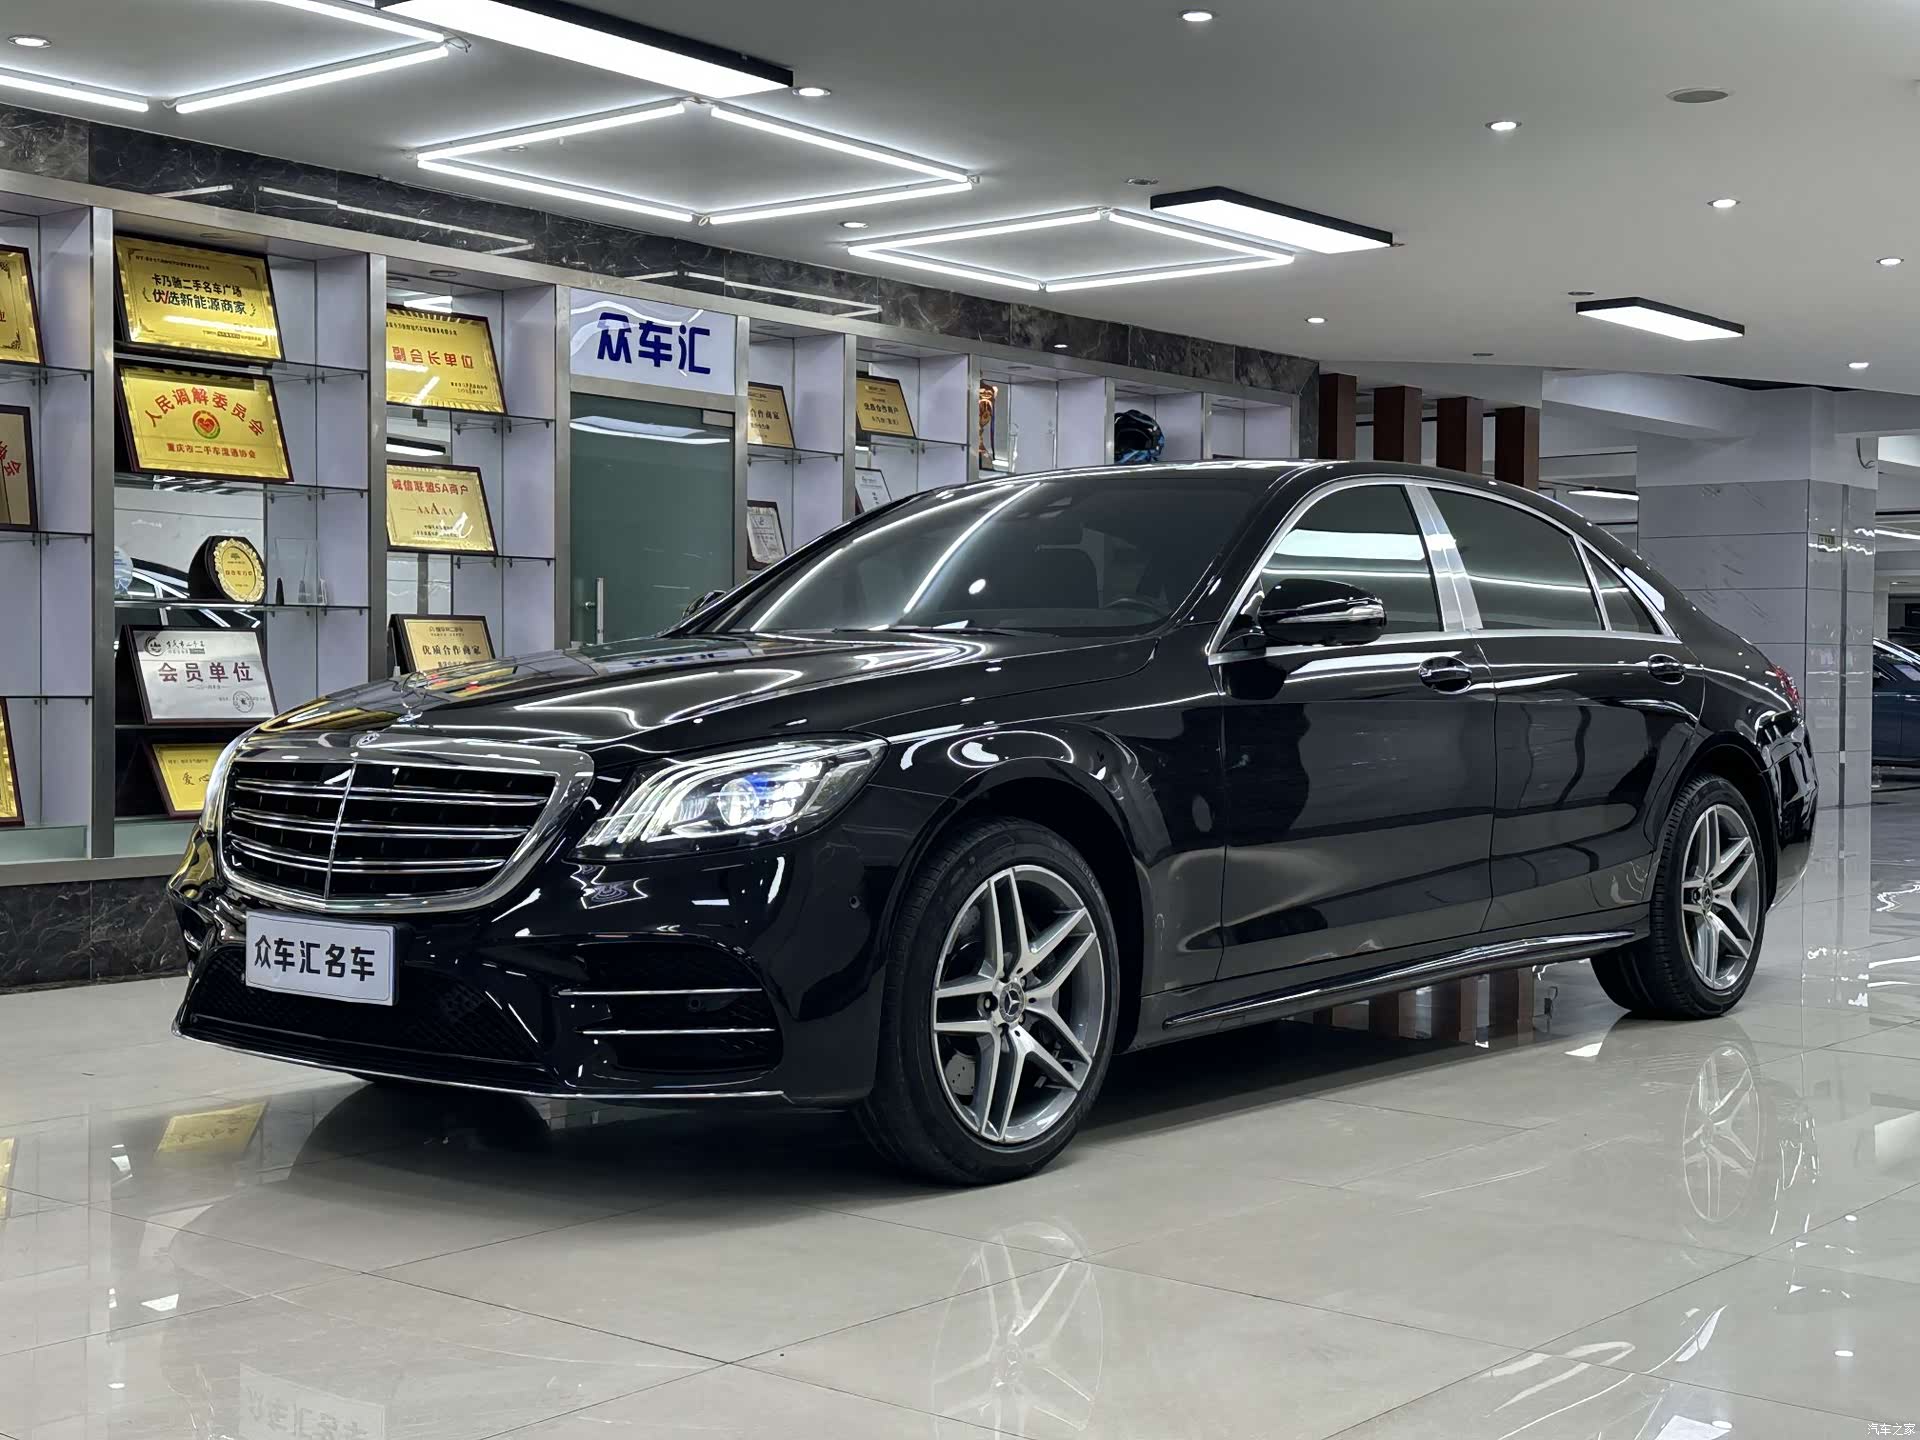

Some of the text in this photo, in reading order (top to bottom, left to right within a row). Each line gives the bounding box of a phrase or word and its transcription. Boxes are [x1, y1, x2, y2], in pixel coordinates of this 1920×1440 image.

[152, 273, 242, 297] 卡乃驰二手名车广场
[152, 289, 247, 315] 优选新能源商家
[597, 312, 711, 374] 众车汇
[392, 346, 474, 369] 副会长单位
[145, 387, 264, 436] 人民调解委员会
[167, 442, 256, 459] 重庆市二手车流通协会
[391, 479, 469, 495] 诚信联盟5A商户
[158, 662, 253, 683] 会员单位
[254, 934, 375, 981] 众车汇名车
